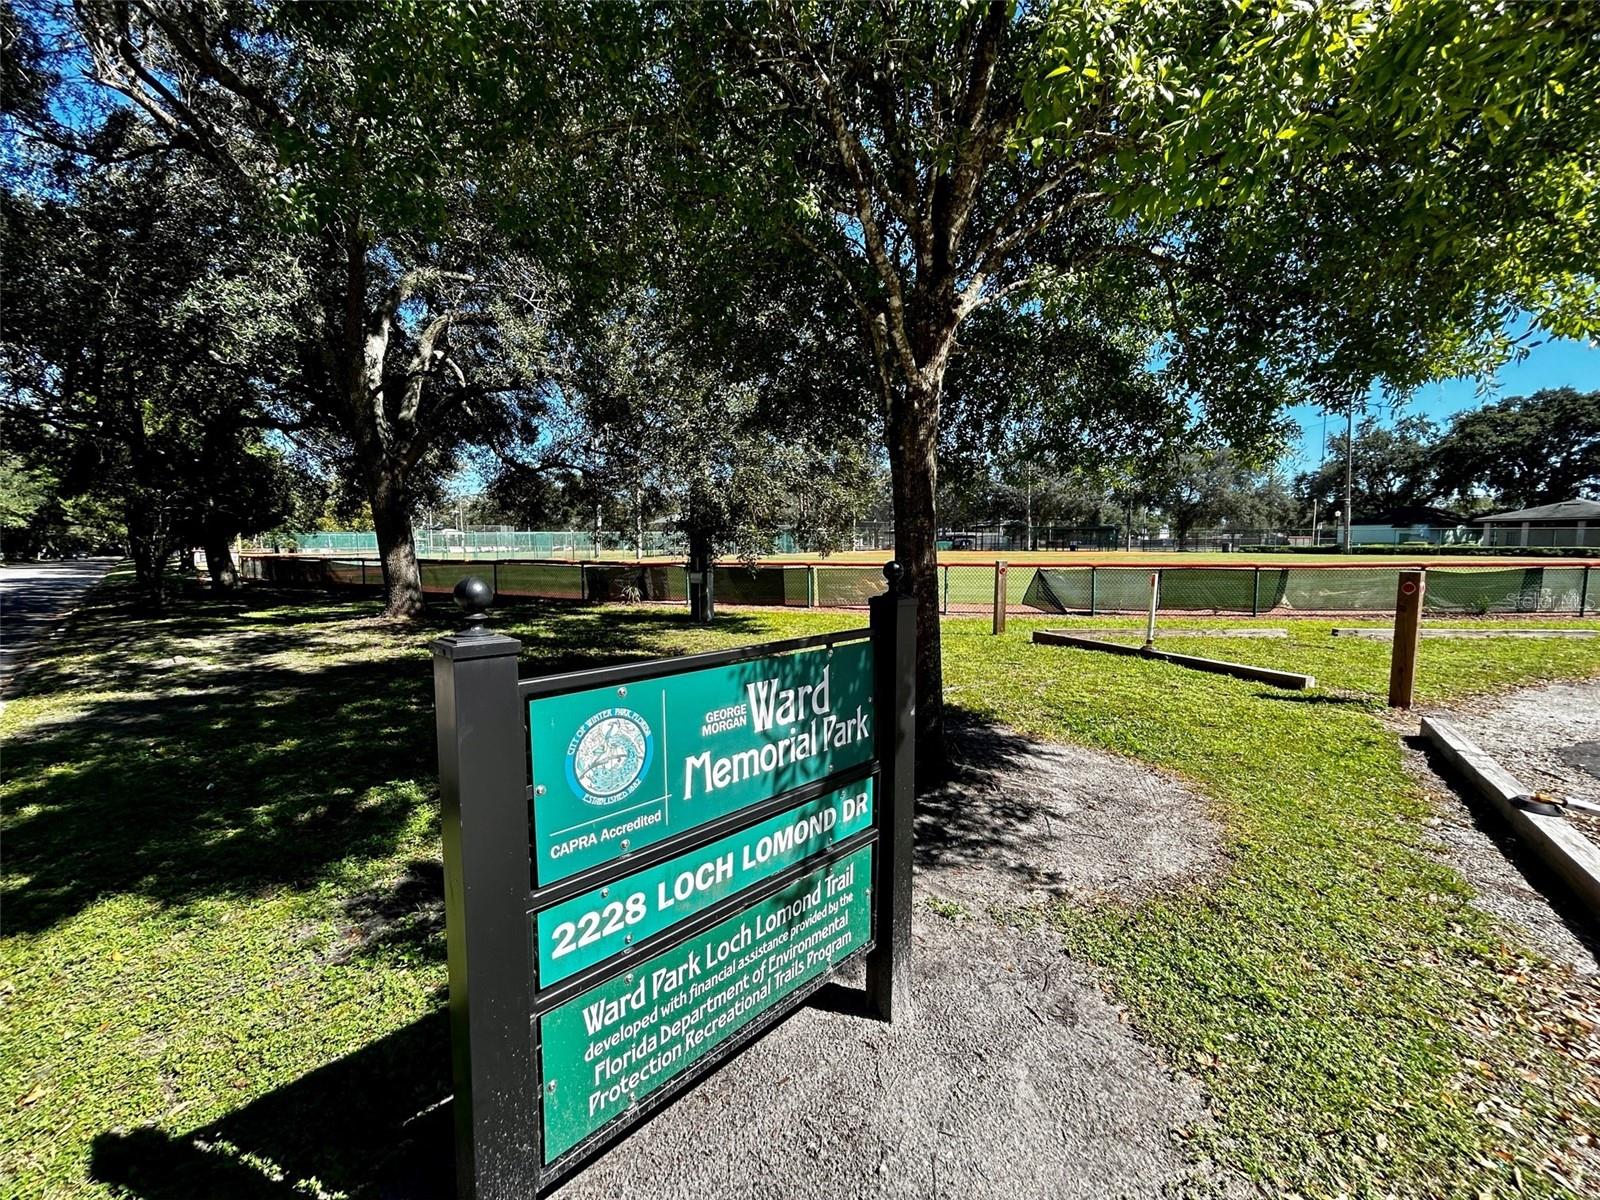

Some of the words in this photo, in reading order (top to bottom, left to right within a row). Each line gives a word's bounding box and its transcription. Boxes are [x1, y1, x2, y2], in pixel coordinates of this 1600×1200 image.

[576, 725, 588, 738] OF
[702, 715, 747, 736] MORGAN
[706, 704, 747, 723] GEORGE
[746, 664, 830, 733] Ward
[683, 718, 817, 800] Memorial
[823, 705, 869, 751] Park
[550, 833, 597, 859] CAPRA
[600, 810, 662, 842] Accredited
[551, 892, 647, 960] 2228
[657, 852, 734, 911] LOCH
[742, 808, 836, 871] LOMOND
[842, 792, 868, 823] DR
[582, 976, 646, 1036] Ward
[652, 950, 701, 1000] Park
[706, 923, 751, 969] Loch
[756, 884, 821, 939] Lomond
[825, 863, 854, 898] Trail
[584, 1005, 658, 1062] developed
[660, 991, 687, 1018] with
[688, 959, 736, 1004] financial
[738, 931, 789, 969] assistance
[790, 905, 827, 940] provided
[828, 900, 839, 917] by
[840, 892, 853, 906] the
[589, 1043, 682, 1117] Protection
[685, 978, 771, 1051] Recreational
[774, 958, 804, 989] Trails
[807, 932, 851, 969] Program
[595, 1033, 657, 1086] Florida
[660, 975, 749, 1045] Department
[752, 959, 767, 983] of
[768, 909, 849, 974] Environmental
